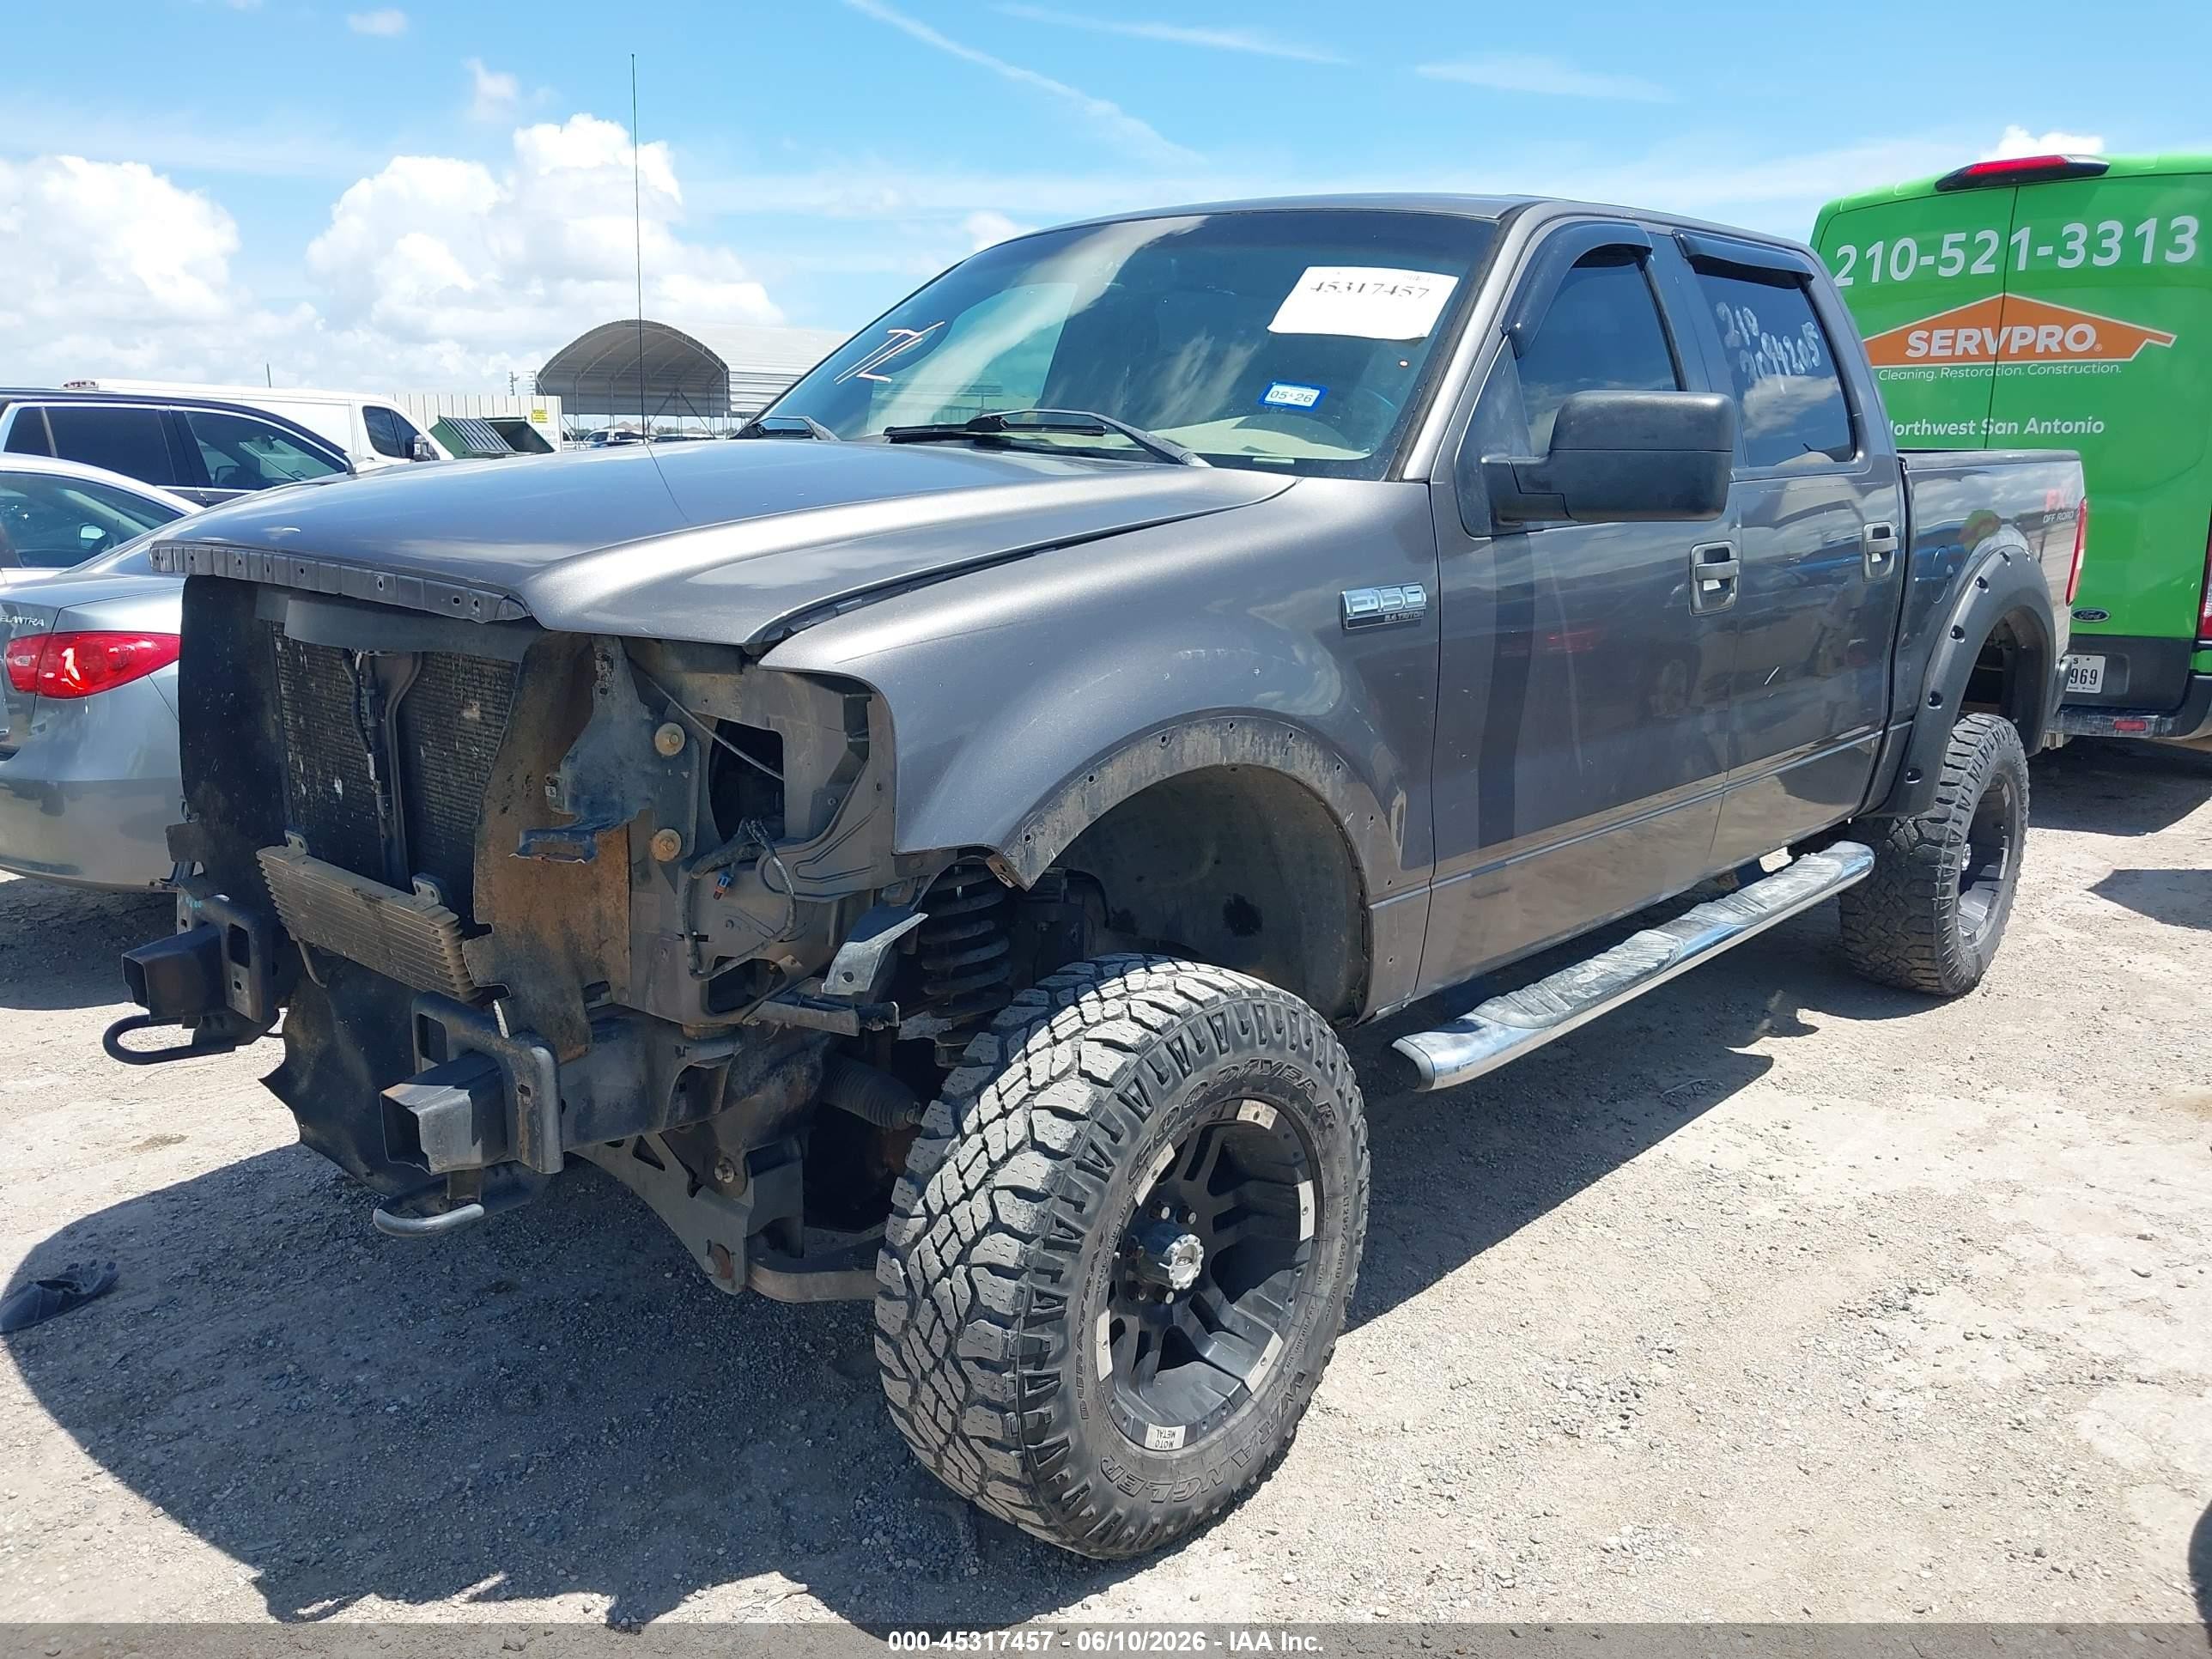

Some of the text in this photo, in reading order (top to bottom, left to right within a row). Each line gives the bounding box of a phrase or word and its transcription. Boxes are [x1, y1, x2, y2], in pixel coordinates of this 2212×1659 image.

[1833, 215, 2199, 288] 210-521-3313
[1310, 281, 1430, 299] 45317457
[1905, 323, 2098, 358] SERVPRO
[1878, 368, 1937, 381] Cleaning.
[2027, 362, 2123, 376] Construction.
[1981, 417, 2018, 435] San
[2024, 416, 2106, 434] Antonio
[2043, 514, 2057, 523] OFF
[0, 614, 45, 627] ELANTRA
[1156, 1429, 1176, 1439] METAL
[1155, 1439, 1175, 1449] MOTO
